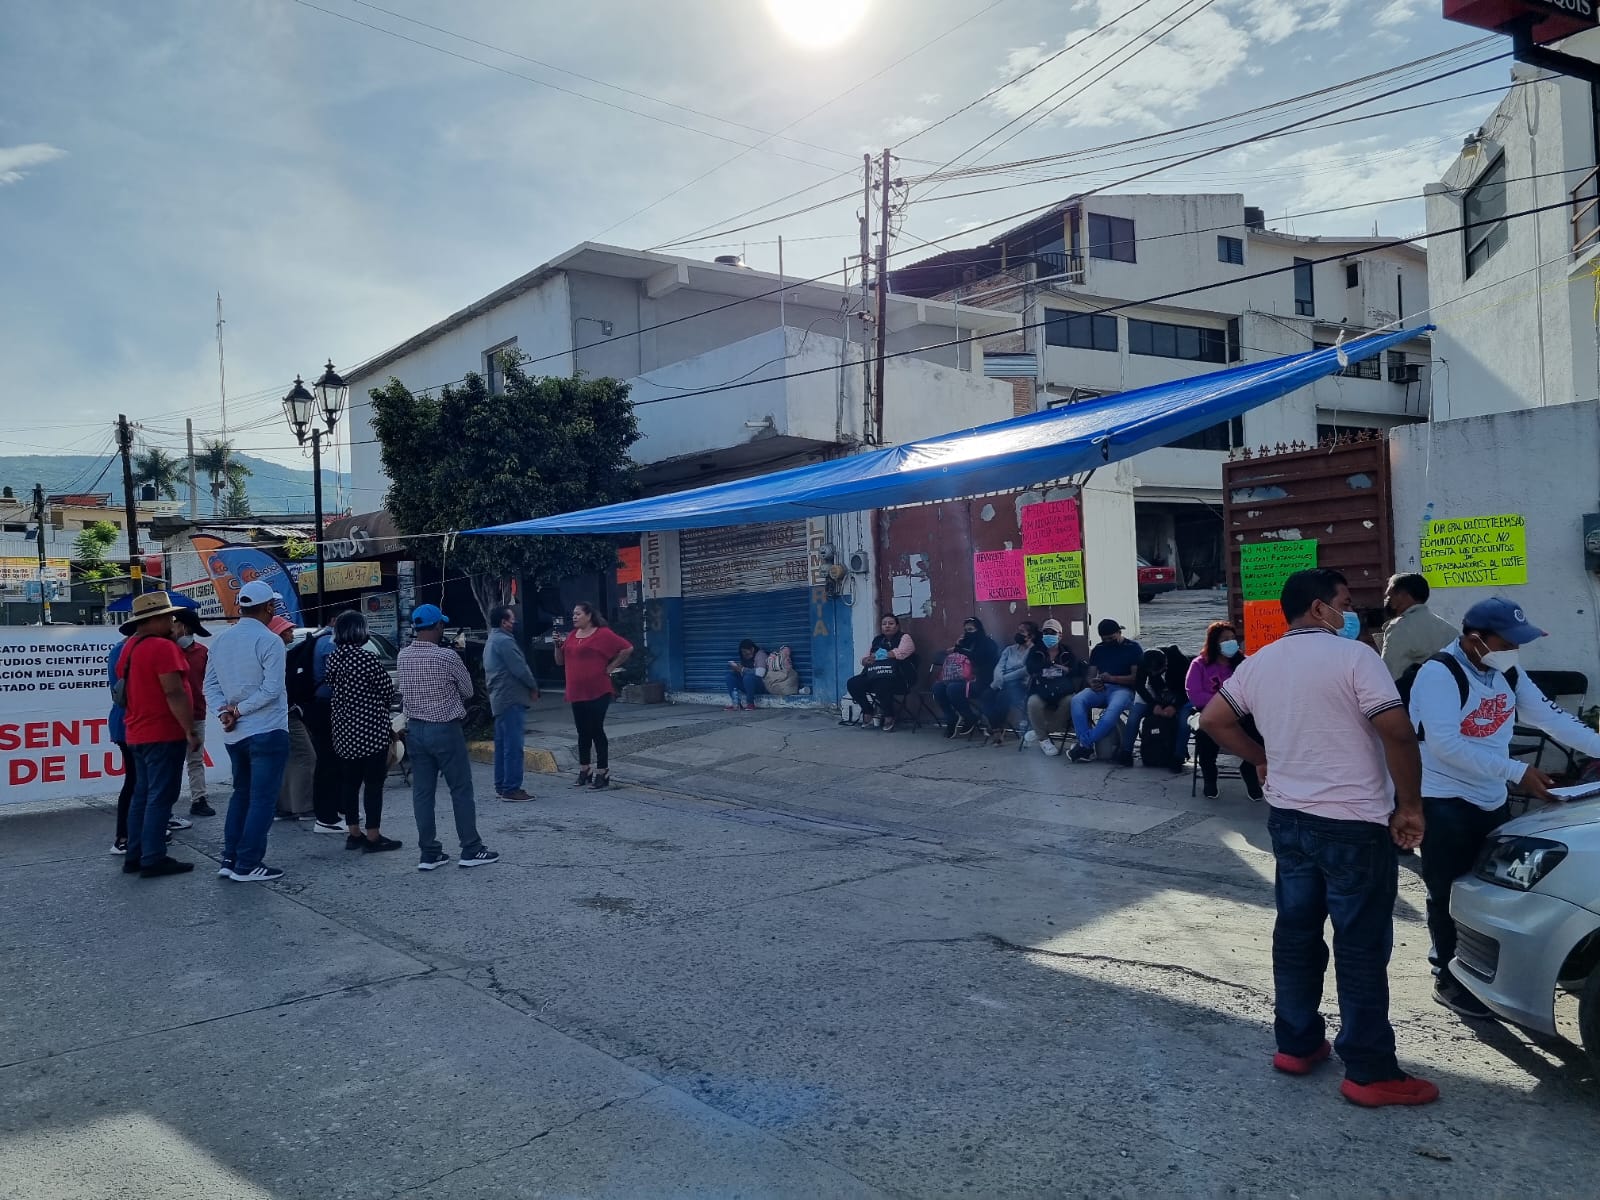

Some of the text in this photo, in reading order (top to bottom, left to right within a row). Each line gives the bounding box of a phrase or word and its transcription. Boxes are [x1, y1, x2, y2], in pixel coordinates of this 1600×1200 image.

[36, 669, 74, 679] MEDIA
[39, 682, 56, 691] DE
[9, 755, 67, 786] DE
